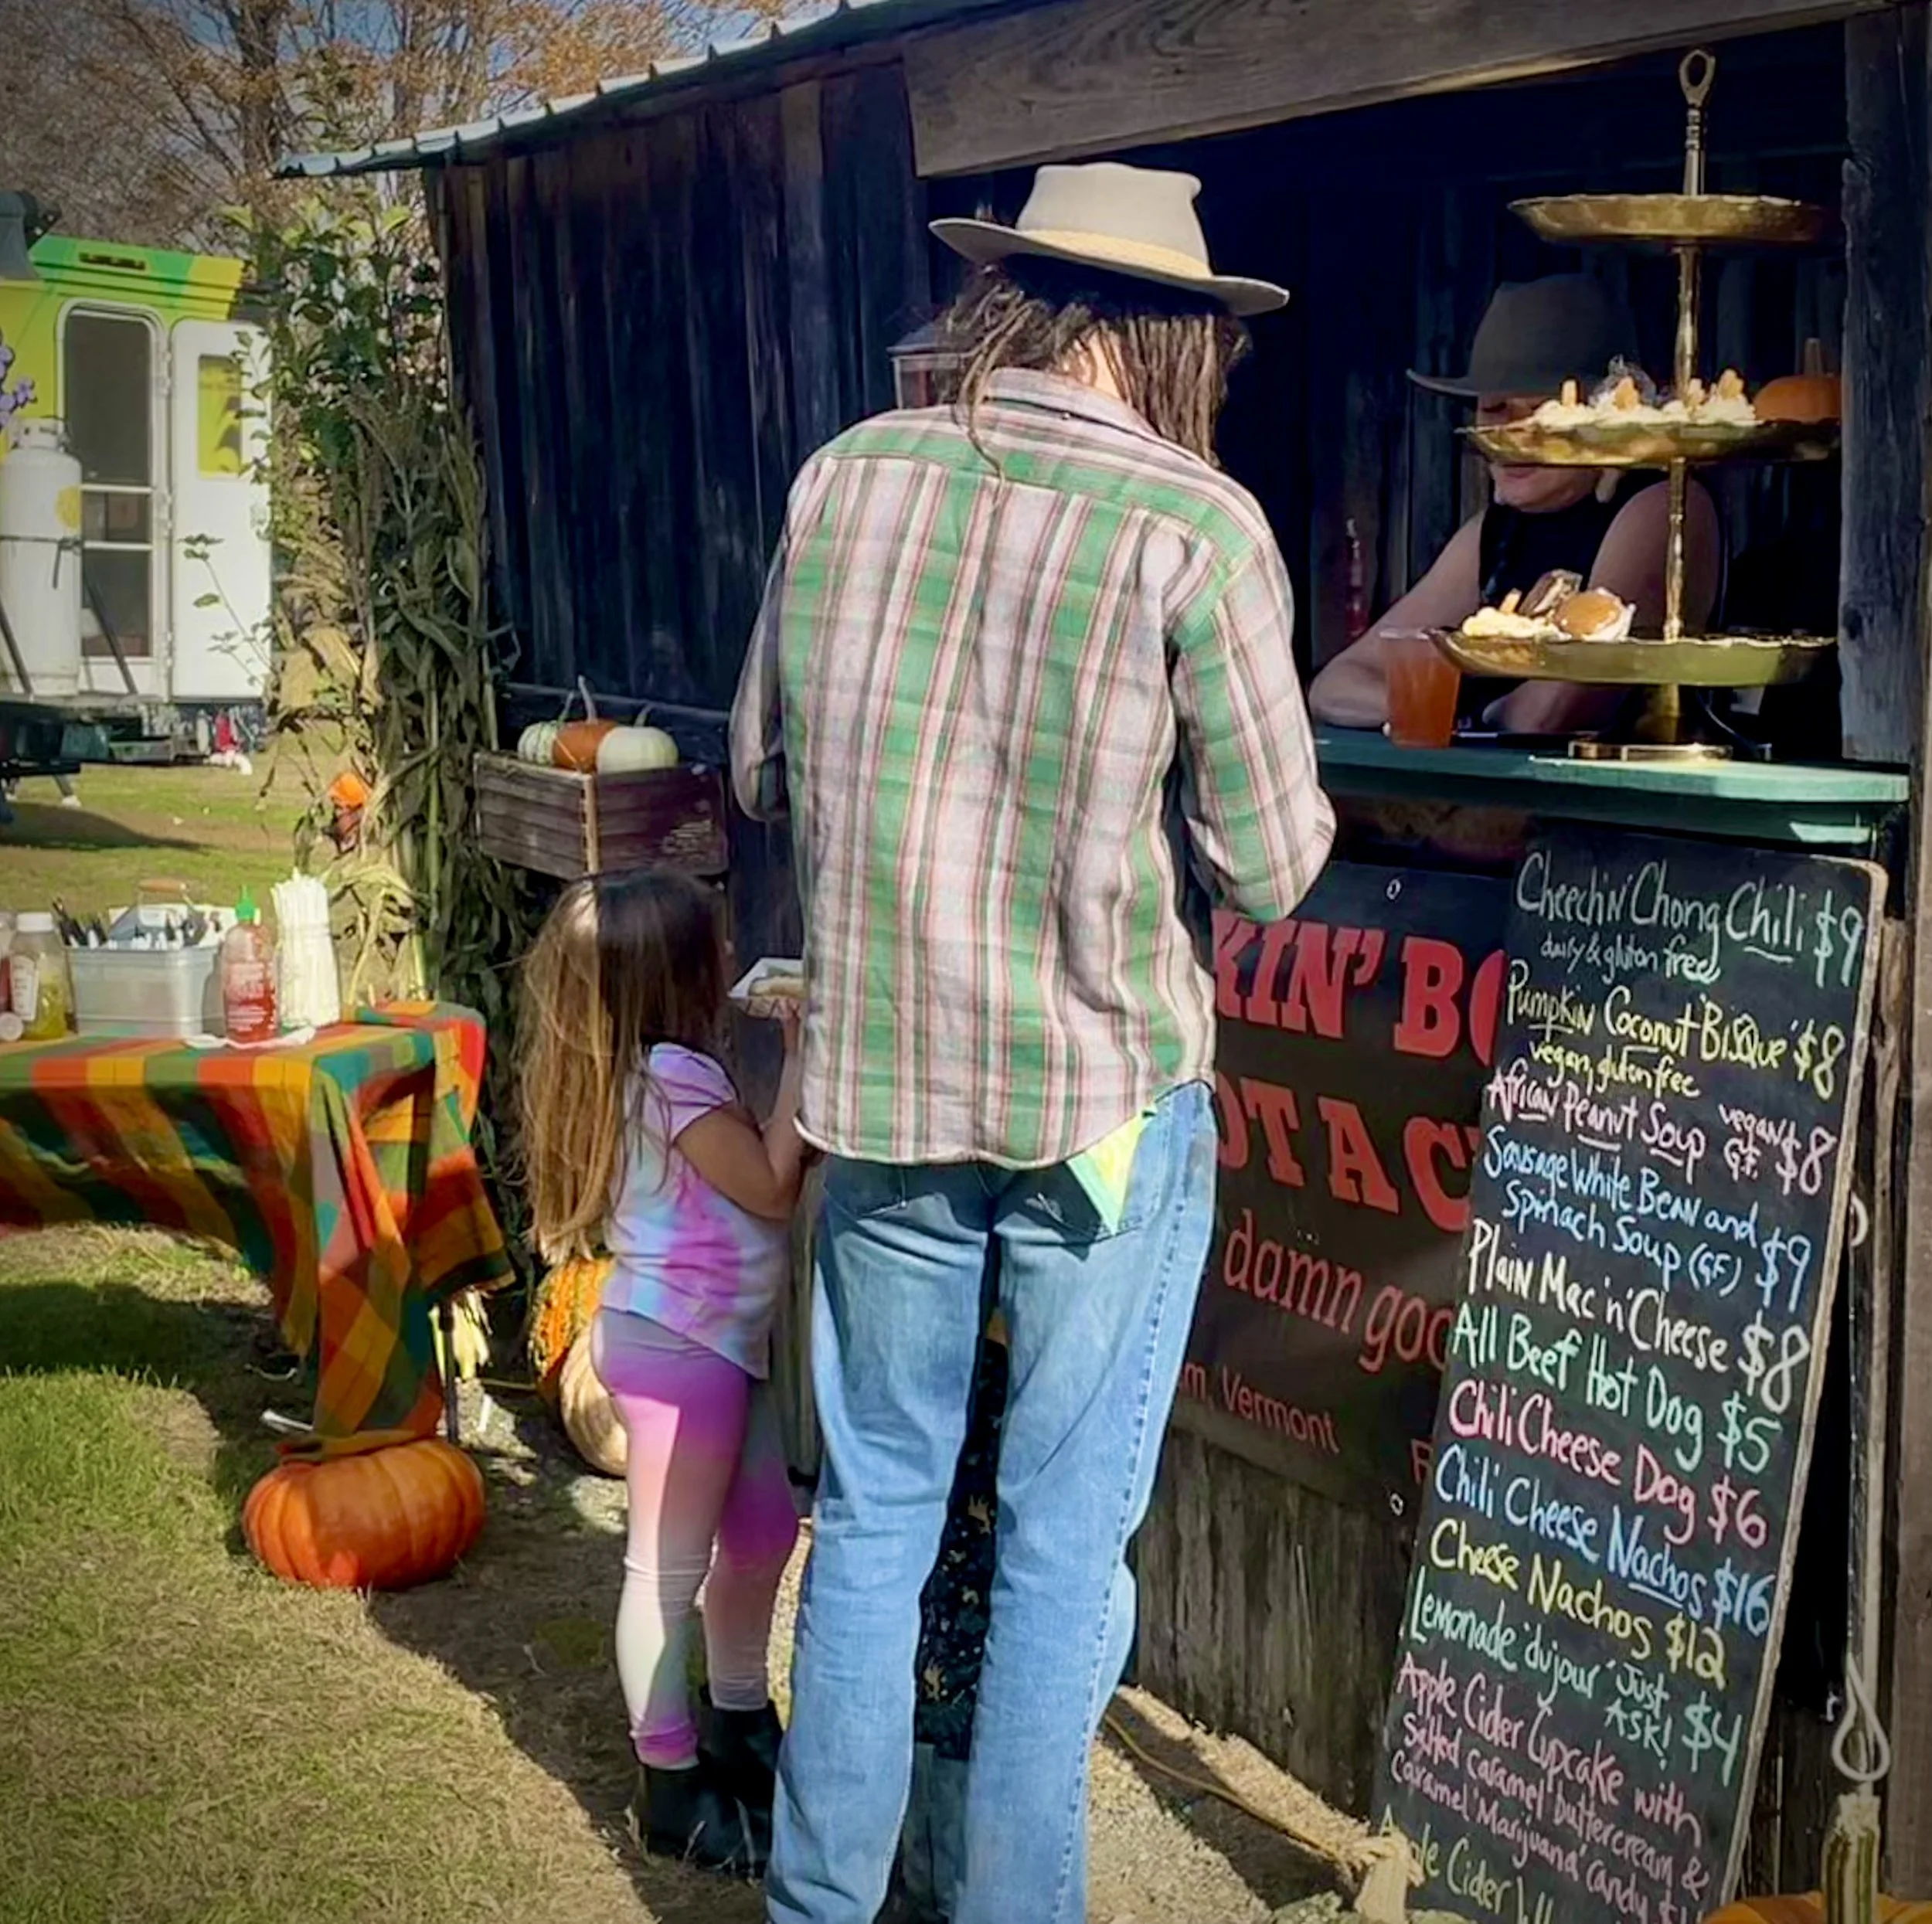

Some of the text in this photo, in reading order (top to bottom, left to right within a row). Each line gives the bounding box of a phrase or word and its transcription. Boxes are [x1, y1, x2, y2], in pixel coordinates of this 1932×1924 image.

[1585, 930, 1602, 967] &
[1664, 933, 1722, 984] free
[1726, 875, 1806, 954] Chili
[1813, 889, 1865, 987] $9
[1604, 984, 1700, 1057] Coconut
[1792, 1018, 1845, 1100] $8
[1652, 1054, 1702, 1100] free
[1317, 1094, 1401, 1215] A
[1402, 1115, 1480, 1232] C
[1483, 1123, 1568, 1199] Sausage
[1570, 1147, 1632, 1212] White
[1703, 1202, 1759, 1249] and
[1563, 1080, 1639, 1142] Peanut
[1640, 1100, 1706, 1185] Soup
[1775, 1120, 1838, 1197] $8
[1222, 1207, 1365, 1334] damn
[1502, 1178, 1812, 1313] Spinach Soup (GF) $9
[1451, 1301, 1783, 1474] All Beef Hot Dog $5
[1539, 1250, 1597, 1321] Mac
[1628, 1286, 1730, 1373] Cheese
[1736, 1308, 1813, 1414] $8
[1222, 1363, 1341, 1455] Vermont
[1448, 1379, 1518, 1447] Chili
[1517, 1392, 1622, 1486] Cheese
[1633, 1443, 1696, 1545] Dog
[1706, 1474, 1767, 1548] $6
[1434, 1443, 1502, 1519] Chili
[1505, 1477, 1600, 1563] Cheese
[1607, 1503, 1708, 1620] Nachos
[1711, 1555, 1777, 1637] $16
[1430, 1518, 1727, 1691] Cheese Nachos $12
[1410, 1565, 1519, 1672] Lemonade
[1616, 1662, 1671, 1720] Just
[1680, 1690, 1743, 1787] $4
[1396, 1650, 1702, 1849] Apple Cider Cupcake with
[1446, 1836, 1512, 1915] Cider
[1680, 1855, 1710, 1902] &
